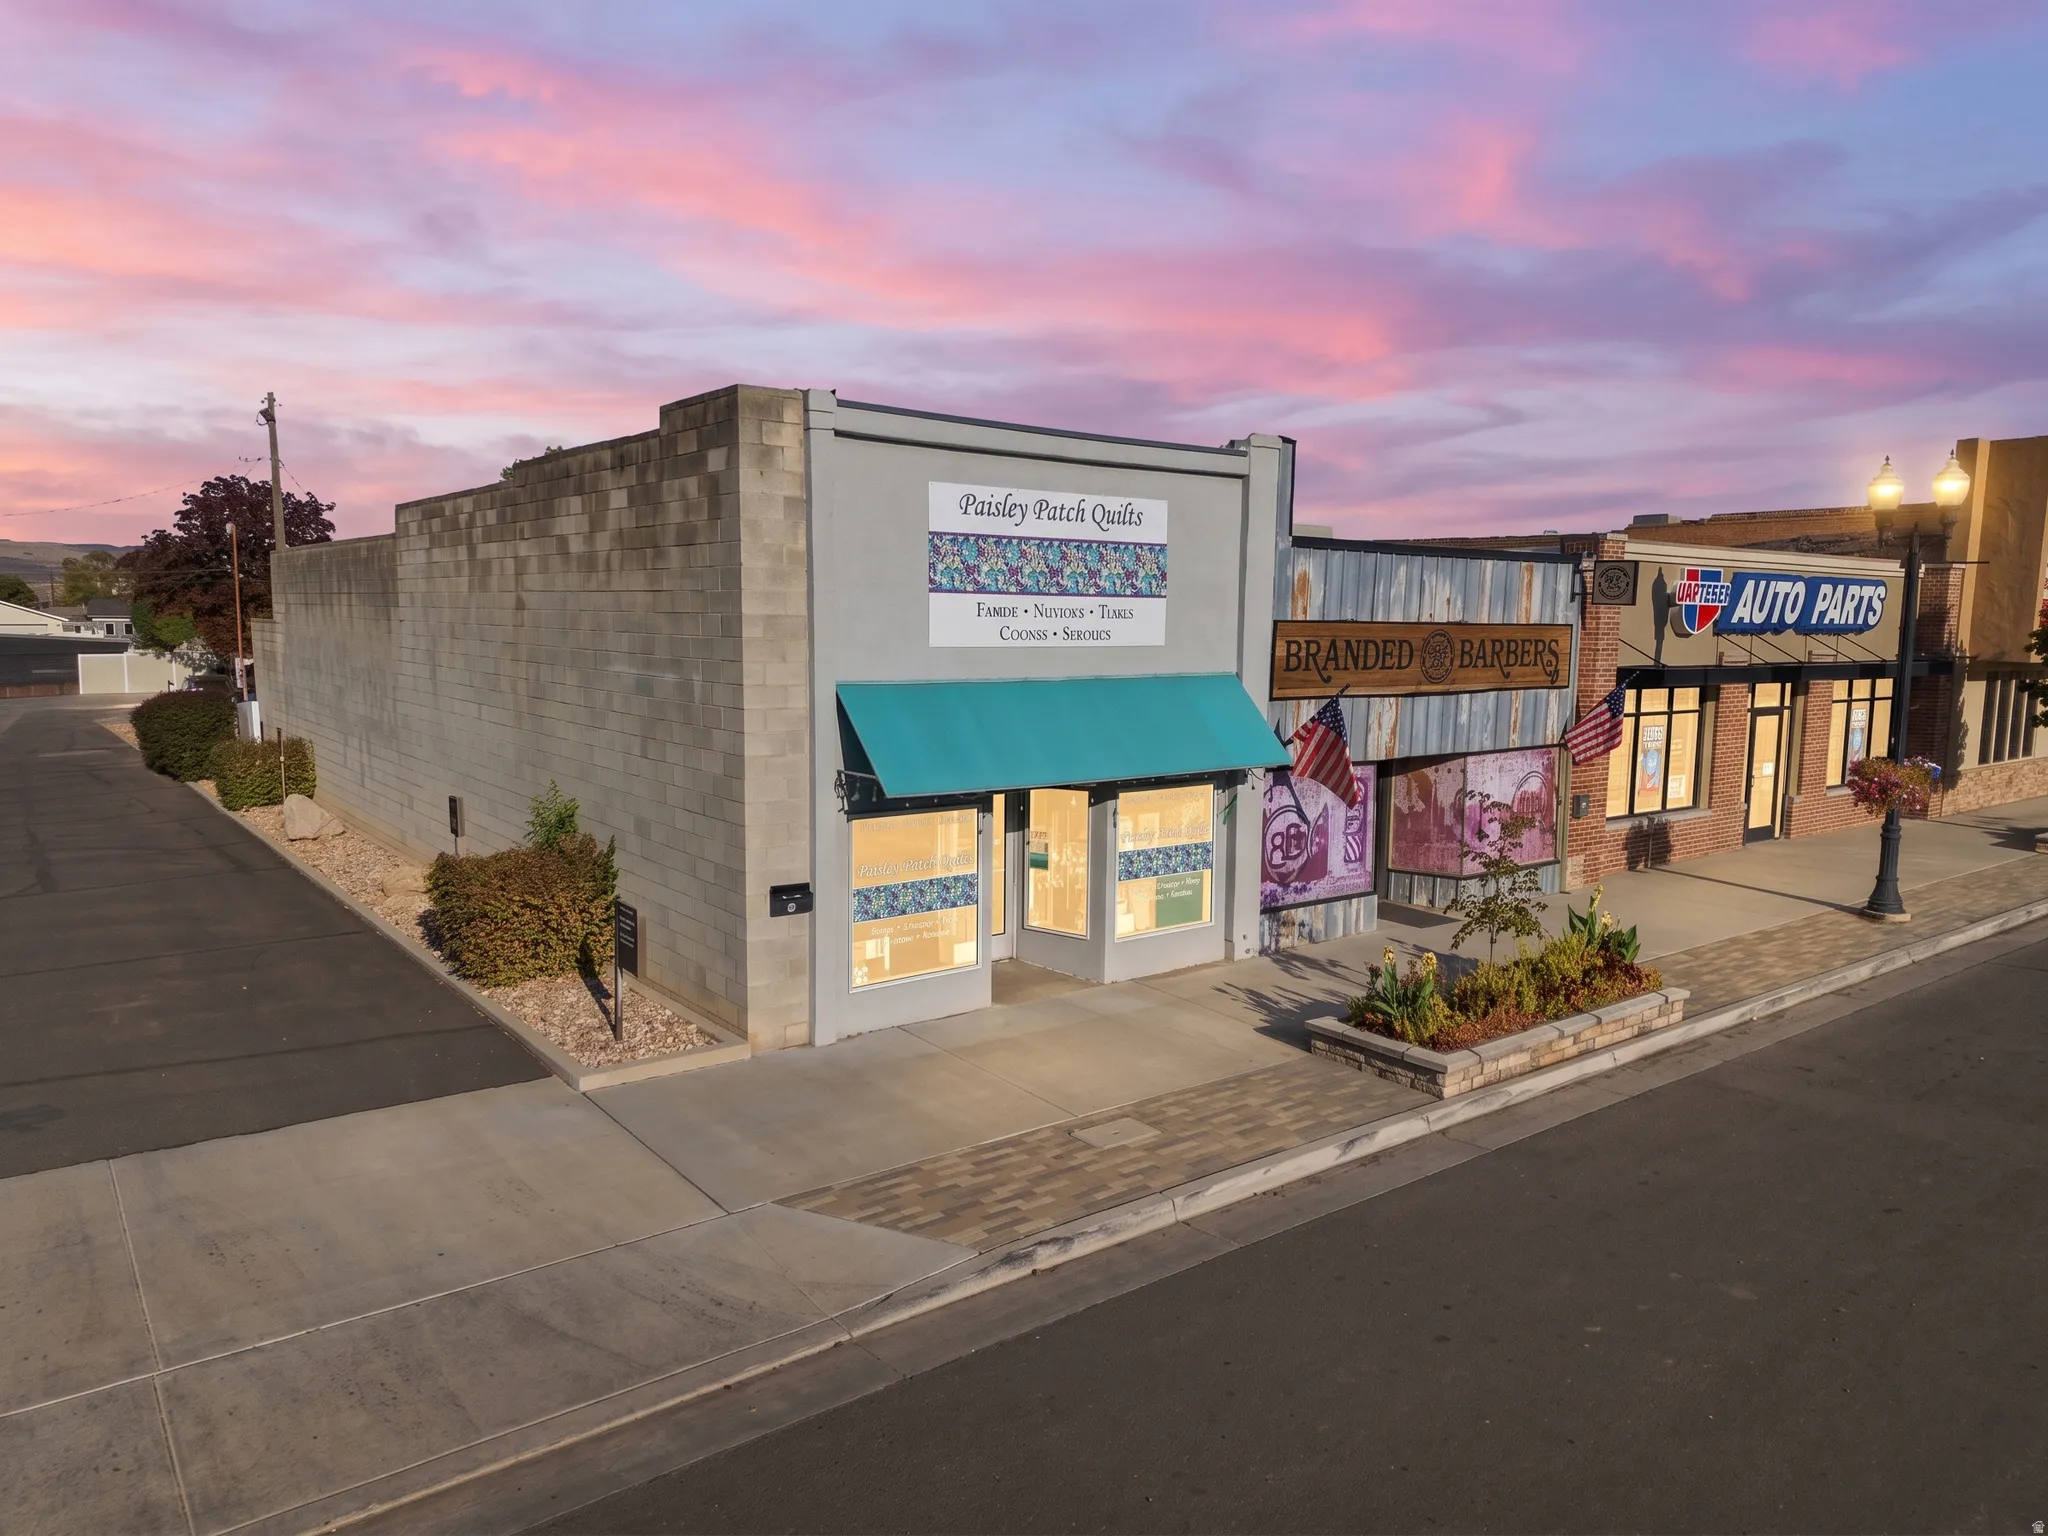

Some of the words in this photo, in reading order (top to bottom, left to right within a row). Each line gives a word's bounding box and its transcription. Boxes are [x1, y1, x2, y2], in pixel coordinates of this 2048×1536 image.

[959, 493, 1028, 527] Paisley
[1033, 499, 1086, 523] Patch
[1092, 502, 1144, 532] Quilts
[1731, 580, 1806, 624] AUTO
[1811, 584, 1886, 625] PARTS
[1283, 639, 1414, 684] BRANDED
[1457, 639, 1560, 685] BARBERS
